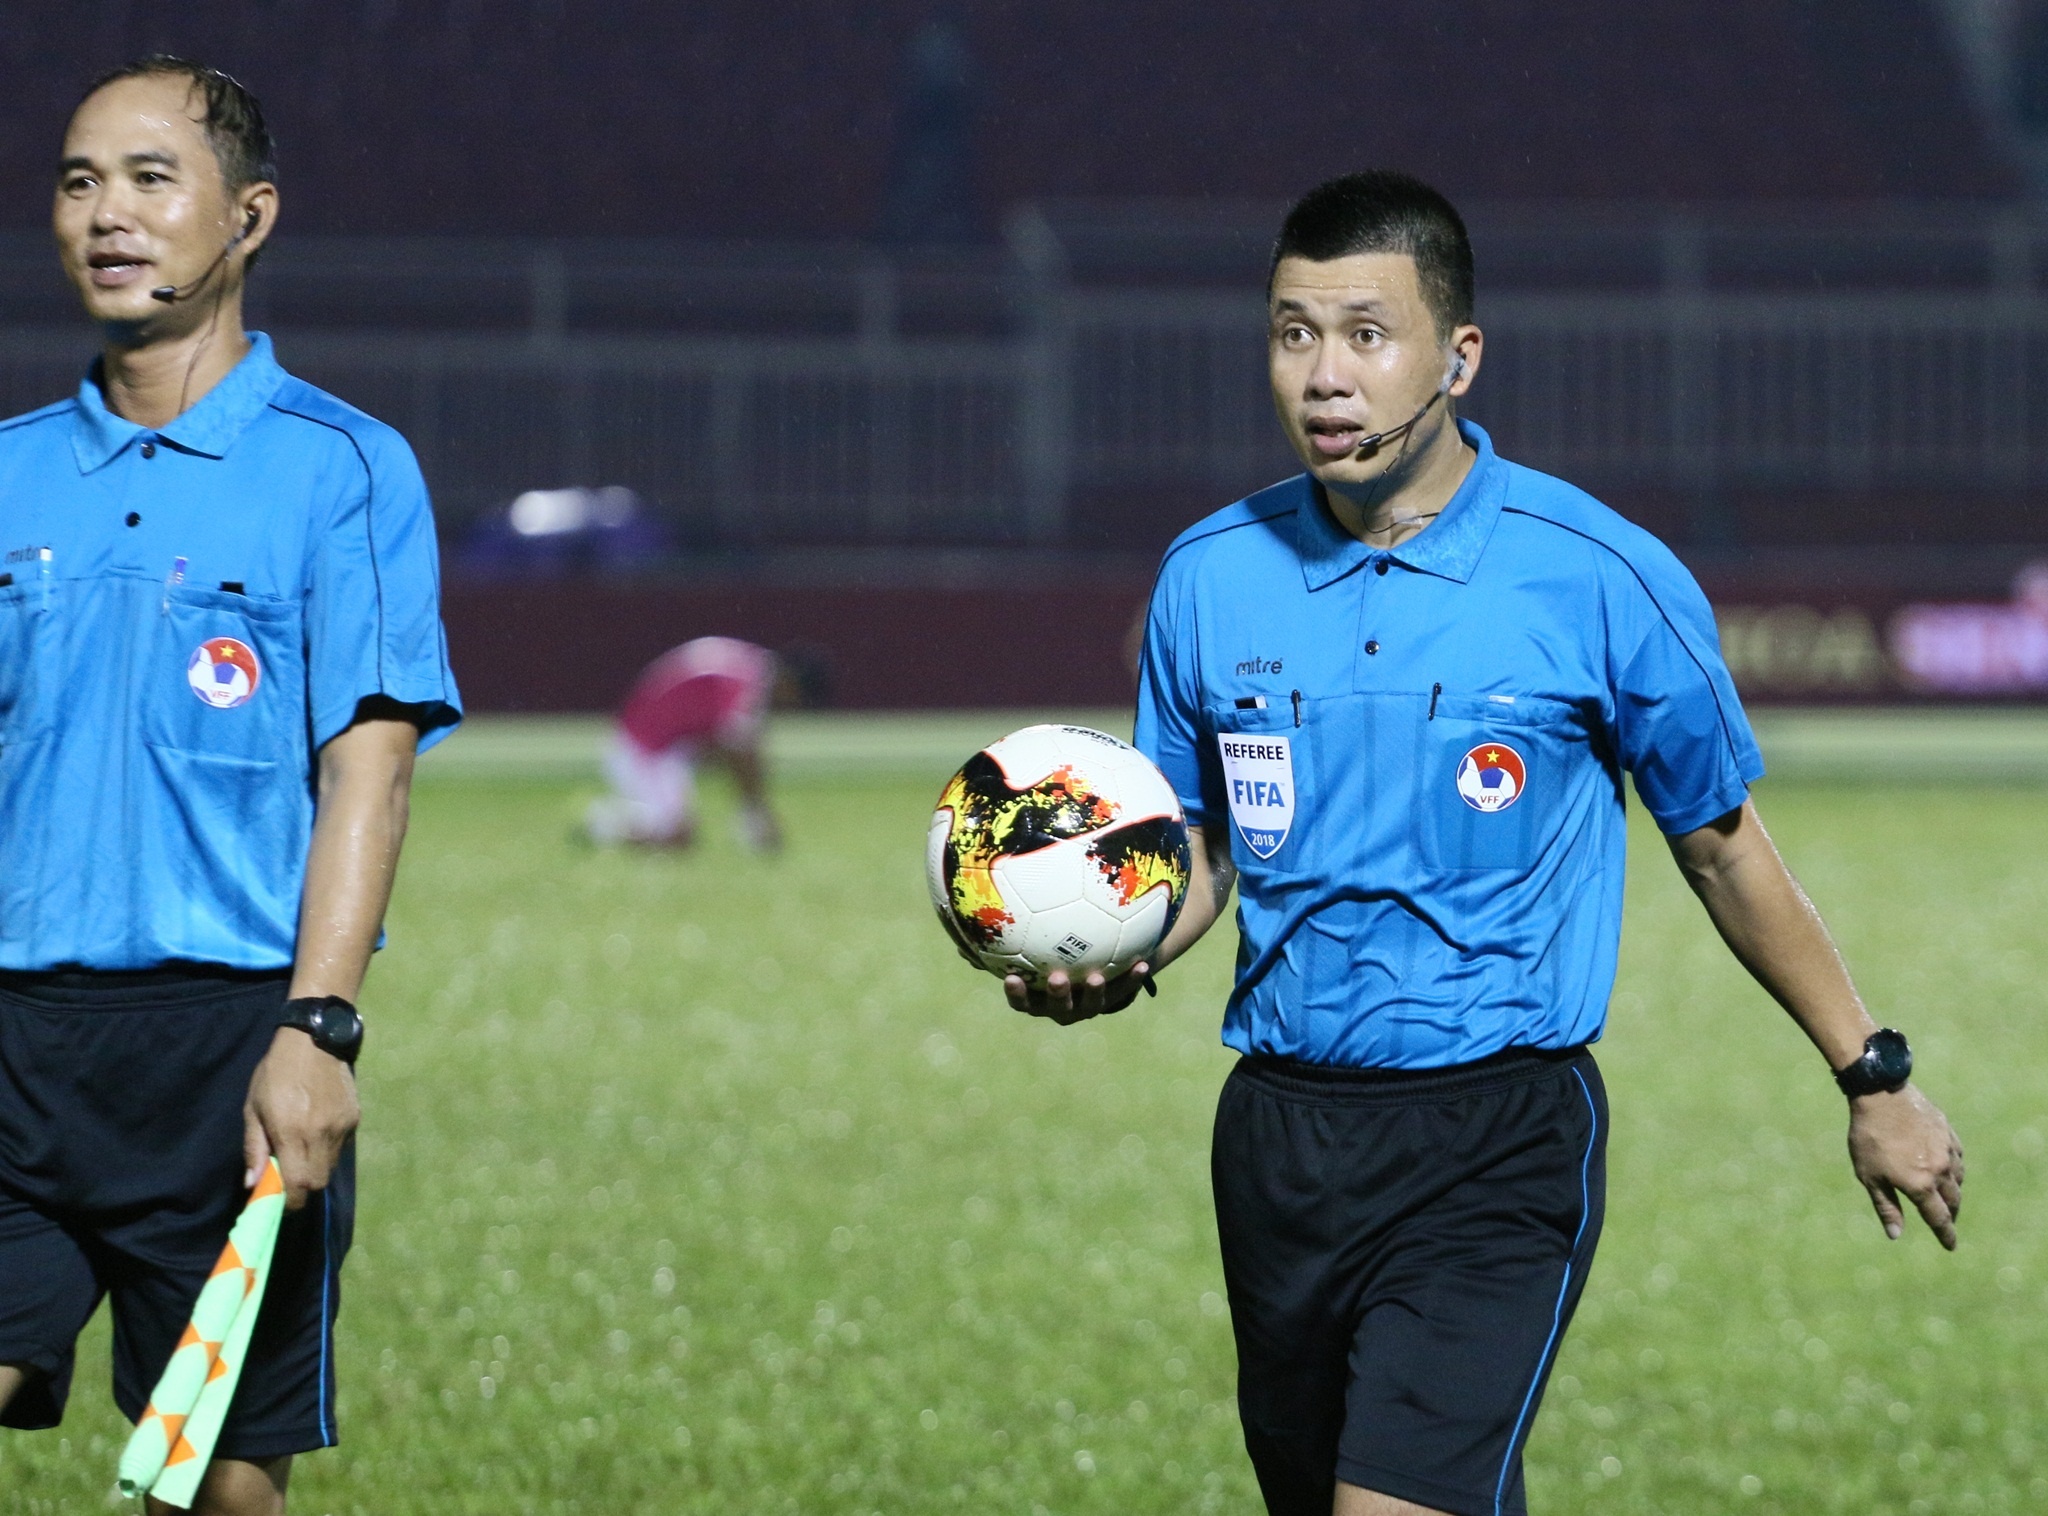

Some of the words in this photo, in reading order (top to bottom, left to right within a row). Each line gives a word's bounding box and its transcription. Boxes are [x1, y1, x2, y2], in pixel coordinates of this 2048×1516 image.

[1236, 656, 1283, 676] mitre
[1224, 743, 1285, 760] REFEREE
[1233, 779, 1285, 807] FIFA
[1480, 795, 1499, 804] VFF
[1251, 833, 1275, 846] 2018
[1066, 936, 1087, 951] FIFA
